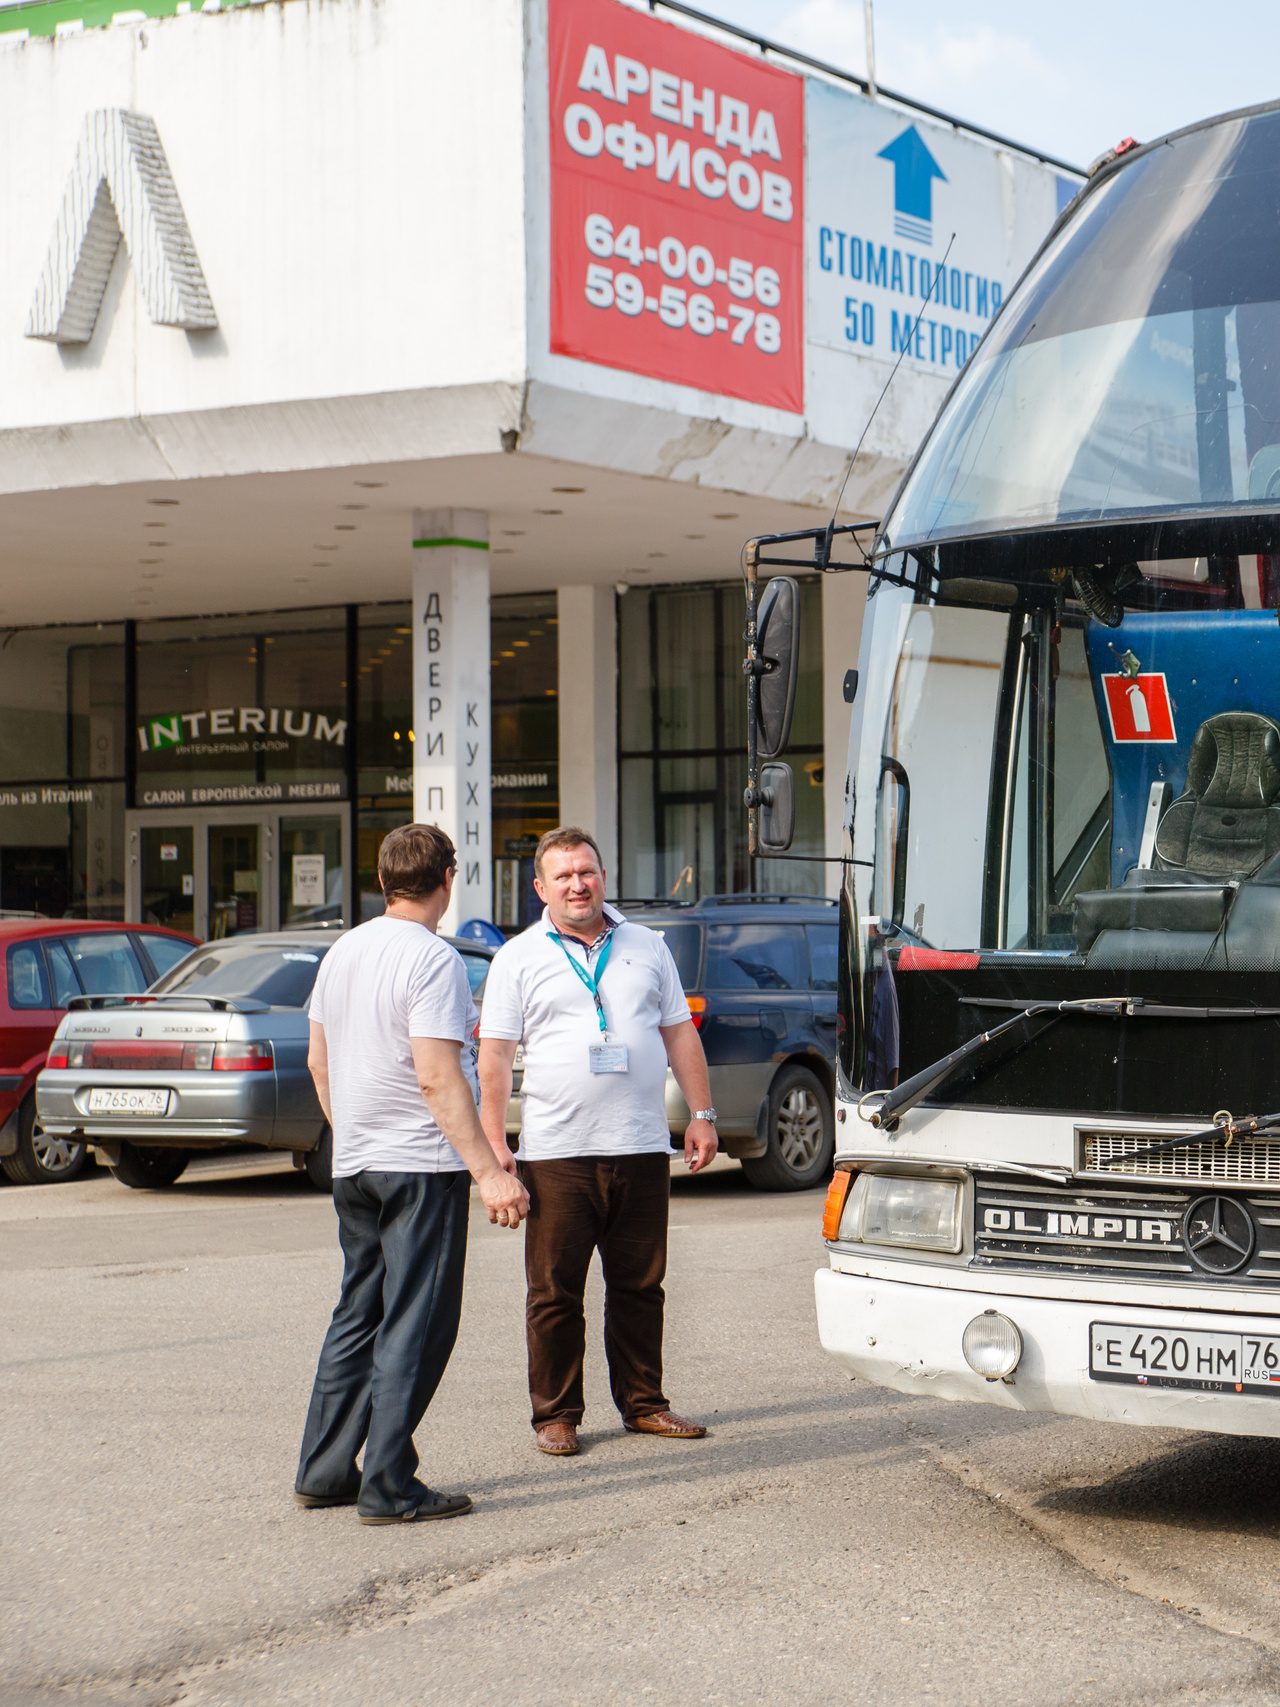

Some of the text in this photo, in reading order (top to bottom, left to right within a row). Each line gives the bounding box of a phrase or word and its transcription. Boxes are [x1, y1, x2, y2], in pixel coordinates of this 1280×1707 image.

[578, 43, 782, 161] АРЕНДА
[564, 103, 793, 222] ОФИСОВ
[585, 214, 780, 307] 64-00-56
[819, 226, 1003, 320] СТОМАТОЛОГИЯ
[585, 263, 780, 353] 59-56-78
[845, 297, 874, 346] 50
[424, 592, 444, 756] ДВЕРИ
[138, 707, 348, 751] INTERIUM
[21, 791, 37, 804] из
[42, 787, 93, 803] Италии
[144, 783, 341, 804] САЛОН ЕВРОПЕЙСКОЙ МЕБЕЛИ
[467, 703, 480, 885] КУХНИ
[984, 1208, 1172, 1242] OLIMPIA
[1244, 1369, 1268, 1380] RUS
[1247, 1340, 1279, 1369] 76
[1159, 1377, 1224, 1392] РОССИЯ
